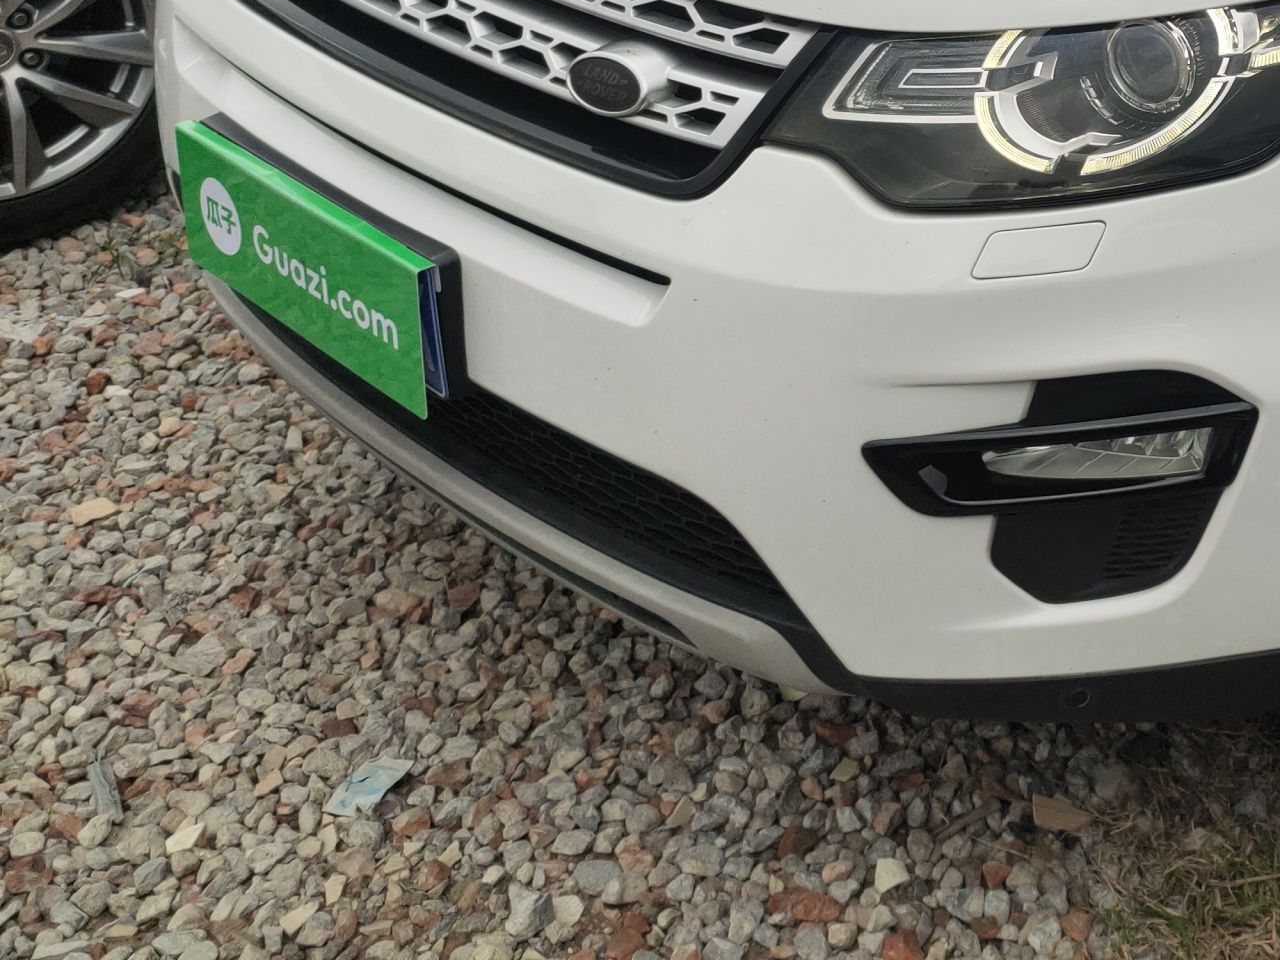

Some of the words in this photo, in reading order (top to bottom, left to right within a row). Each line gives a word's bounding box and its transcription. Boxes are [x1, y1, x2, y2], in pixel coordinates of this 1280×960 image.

[583, 63, 620, 85] LAND
[583, 80, 627, 103] ROVER
[205, 195, 237, 235] 瓜子
[252, 224, 399, 350] Guazi.com
